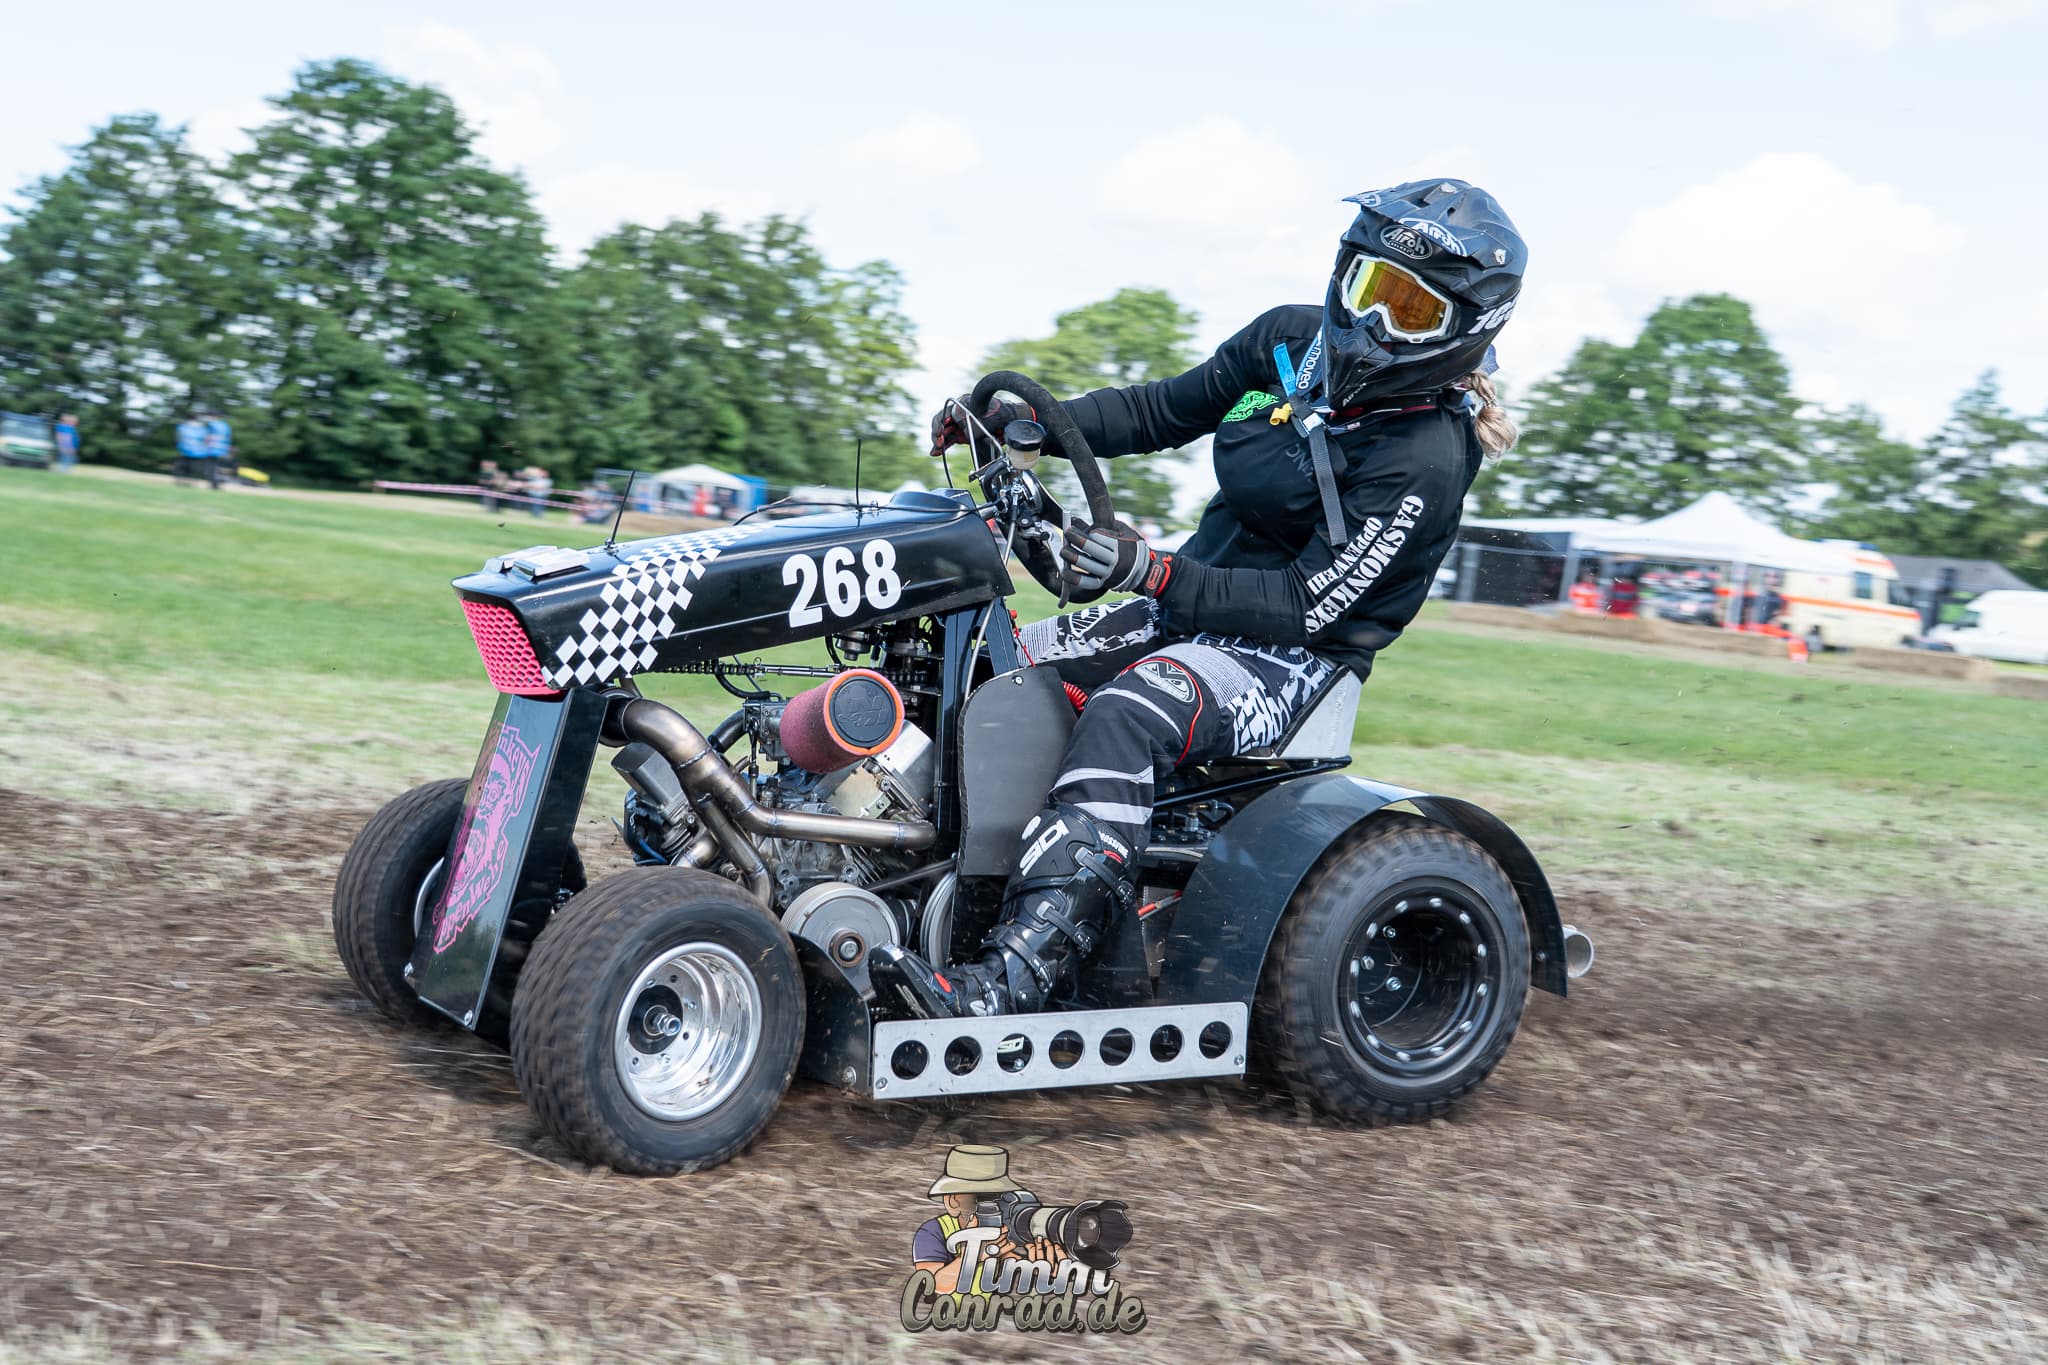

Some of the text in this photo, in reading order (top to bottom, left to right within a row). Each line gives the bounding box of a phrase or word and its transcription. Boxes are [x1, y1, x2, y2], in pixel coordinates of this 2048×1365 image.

[1384, 228, 1426, 254] Airoh
[782, 539, 901, 628] 268
[1304, 495, 1424, 634] GASMONKEYS
